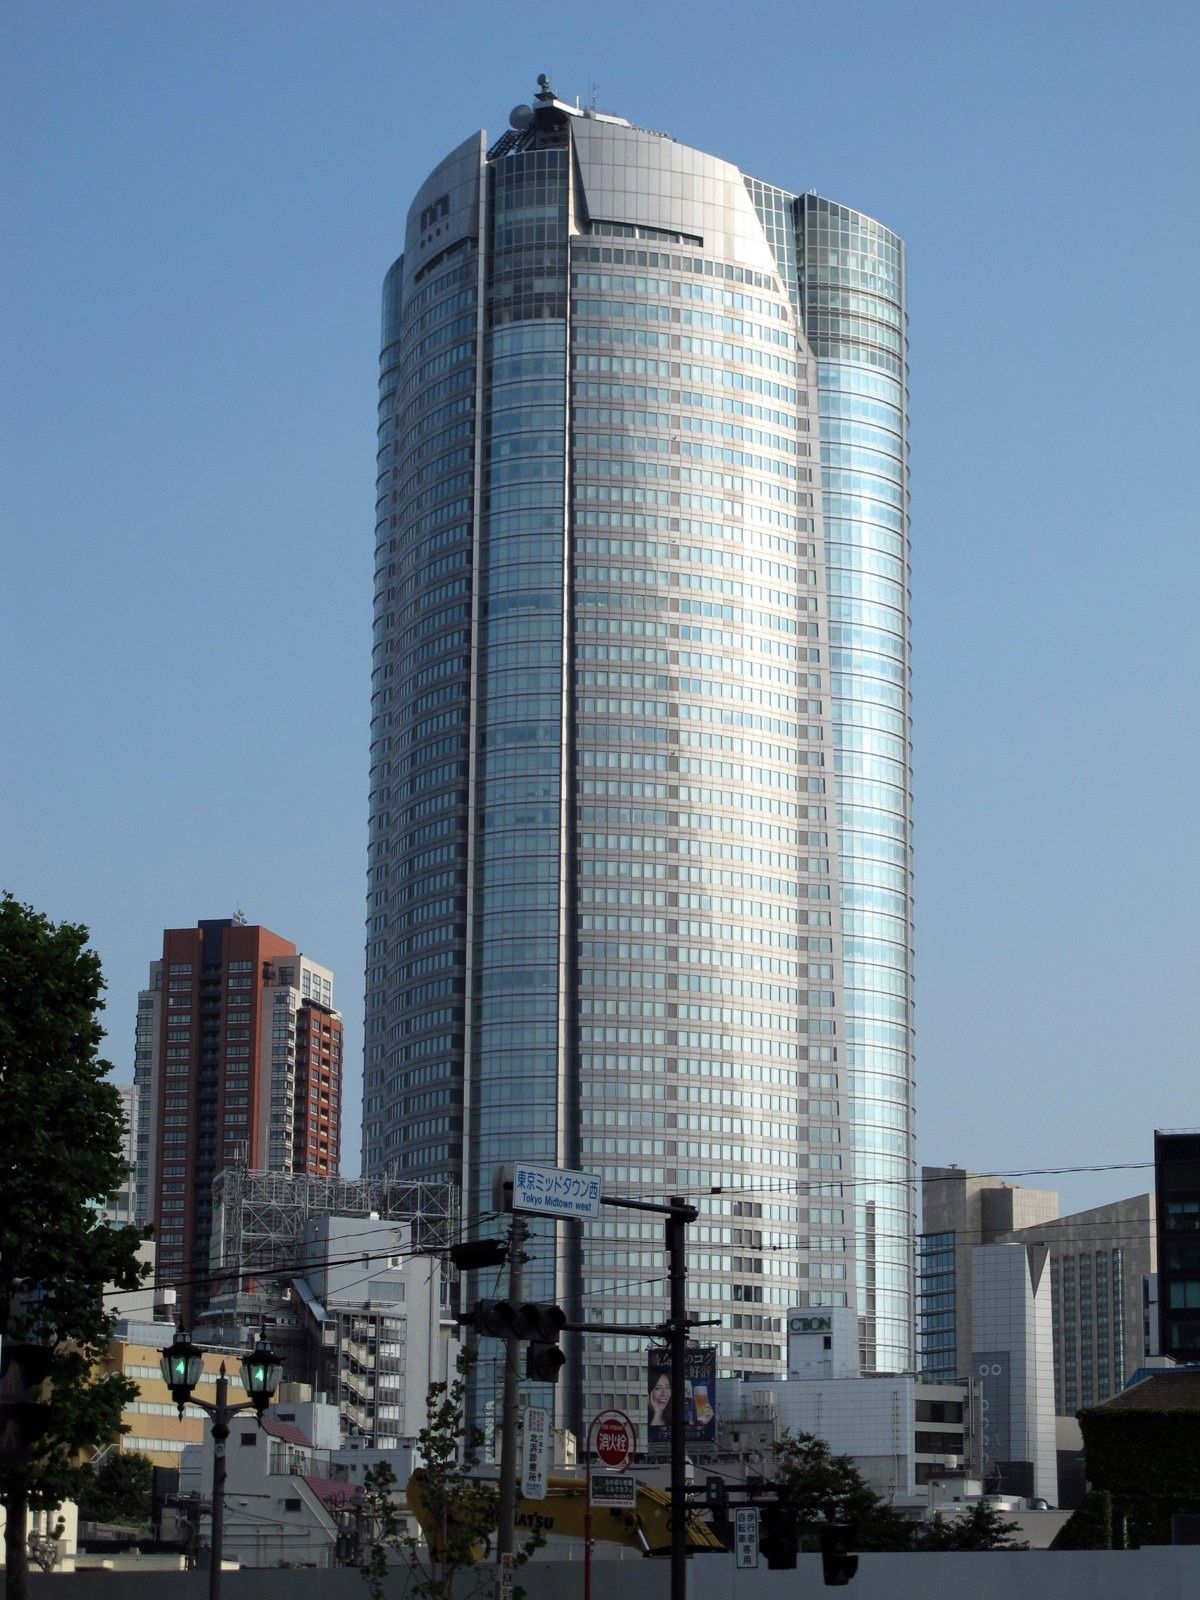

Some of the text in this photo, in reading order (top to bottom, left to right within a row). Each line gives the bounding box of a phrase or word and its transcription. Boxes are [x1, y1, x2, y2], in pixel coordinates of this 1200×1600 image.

[517, 1170, 598, 1200] 東京ミッドタウン西
[522, 1192, 592, 1212] Tokyo Midtown west
[599, 1433, 627, 1452] 消火栓
